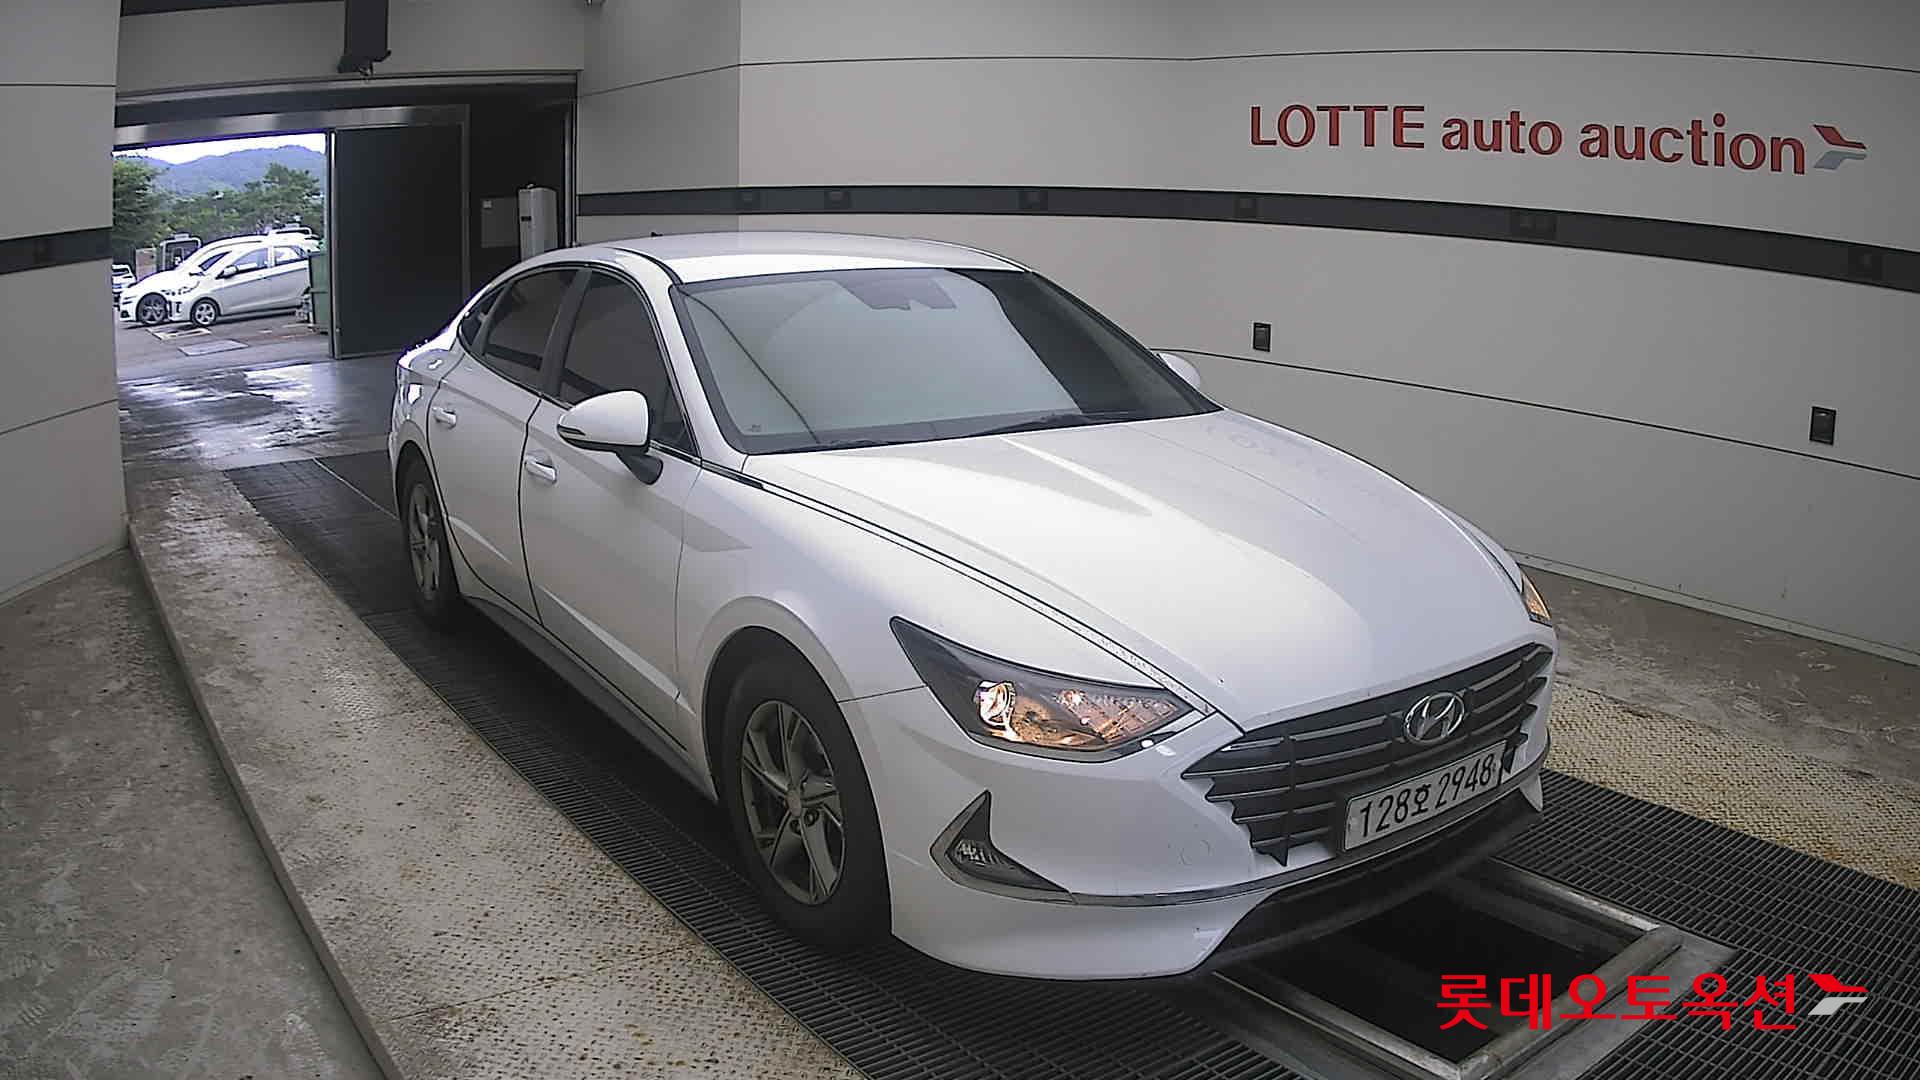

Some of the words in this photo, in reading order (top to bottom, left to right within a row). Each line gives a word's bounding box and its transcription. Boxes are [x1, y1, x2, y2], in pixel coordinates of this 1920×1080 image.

[1250, 104, 1425, 148] LOTTE
[1441, 110, 1563, 156] auto
[1578, 113, 1806, 175] auction
[1435, 753, 1494, 810] 2948
